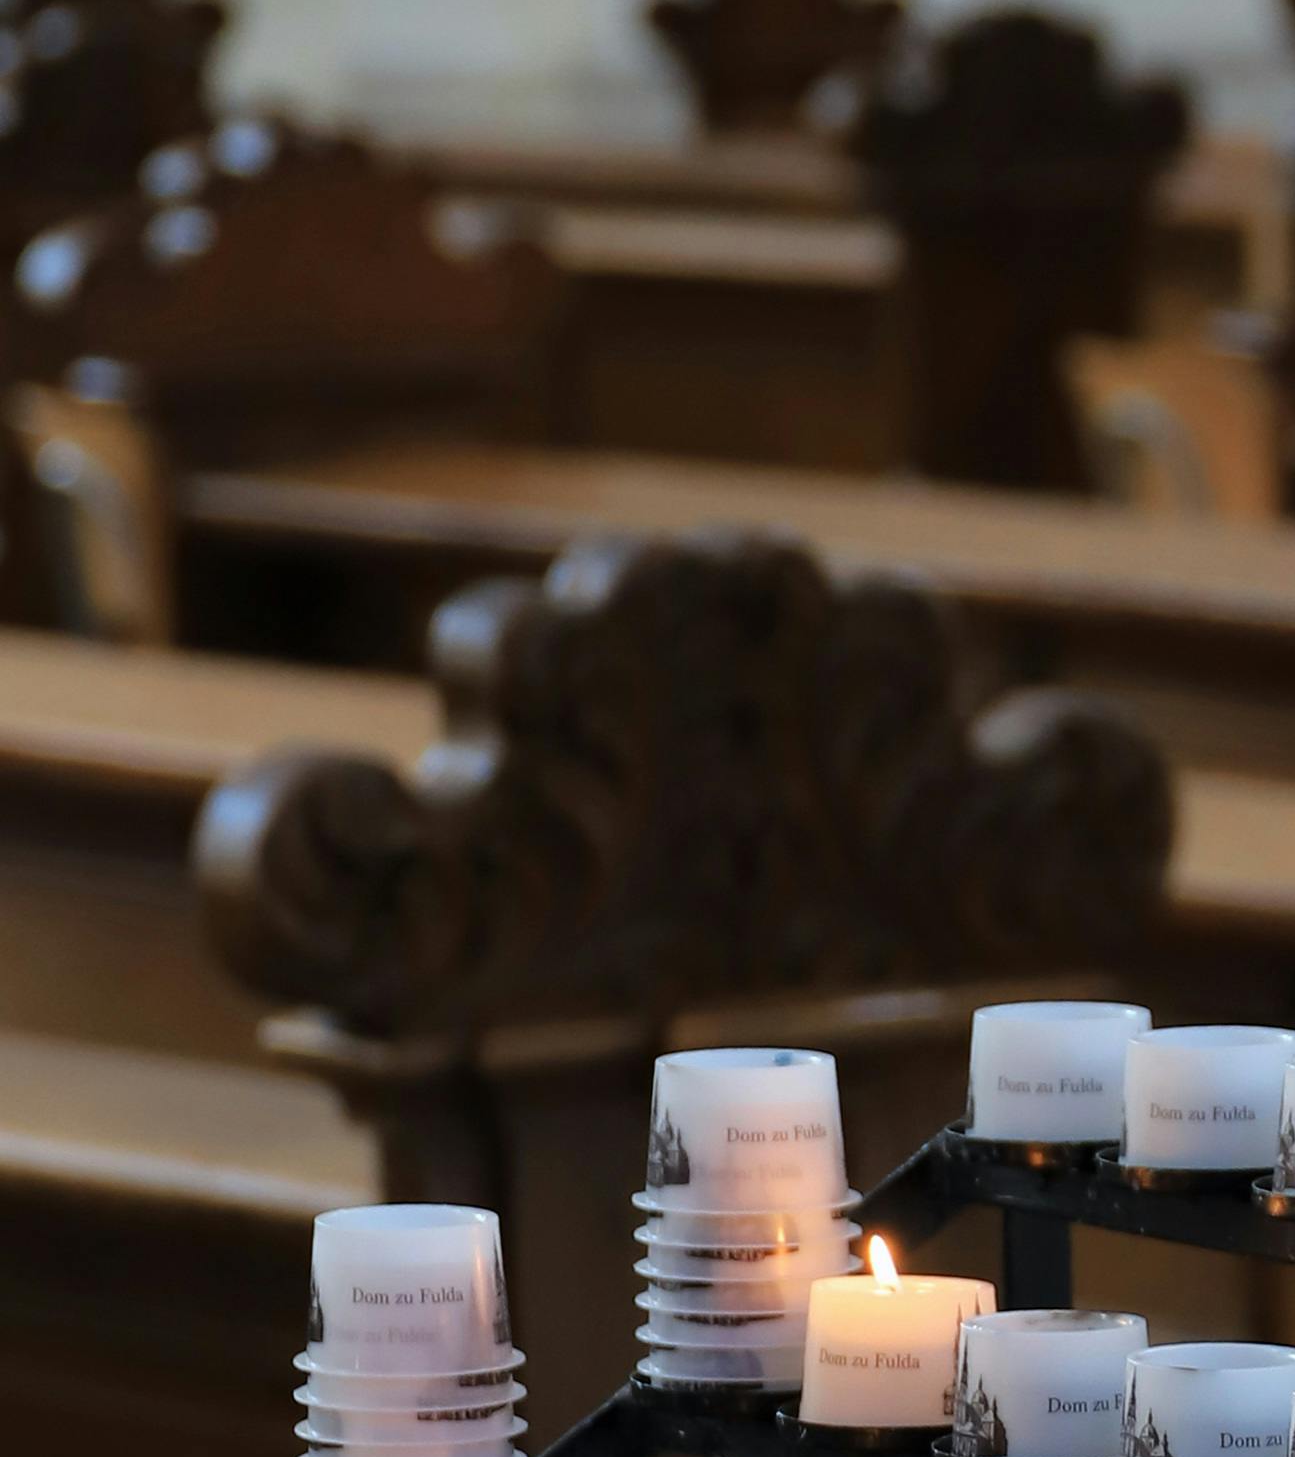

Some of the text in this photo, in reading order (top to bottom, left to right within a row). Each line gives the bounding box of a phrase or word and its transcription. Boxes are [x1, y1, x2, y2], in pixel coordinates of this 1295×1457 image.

[997, 1075, 1103, 1093] Dom zu Fulda
[1150, 1103, 1256, 1122] Dom zu Fulda
[726, 1124, 827, 1143] Dom zu Fulda
[352, 1286, 464, 1305] Dom zu Fulda
[819, 1348, 921, 1370] Dom zu Fulda
[1047, 1396, 1089, 1414] Dom
[1093, 1399, 1111, 1413] zu
[1219, 1432, 1283, 1449] Dom zu
